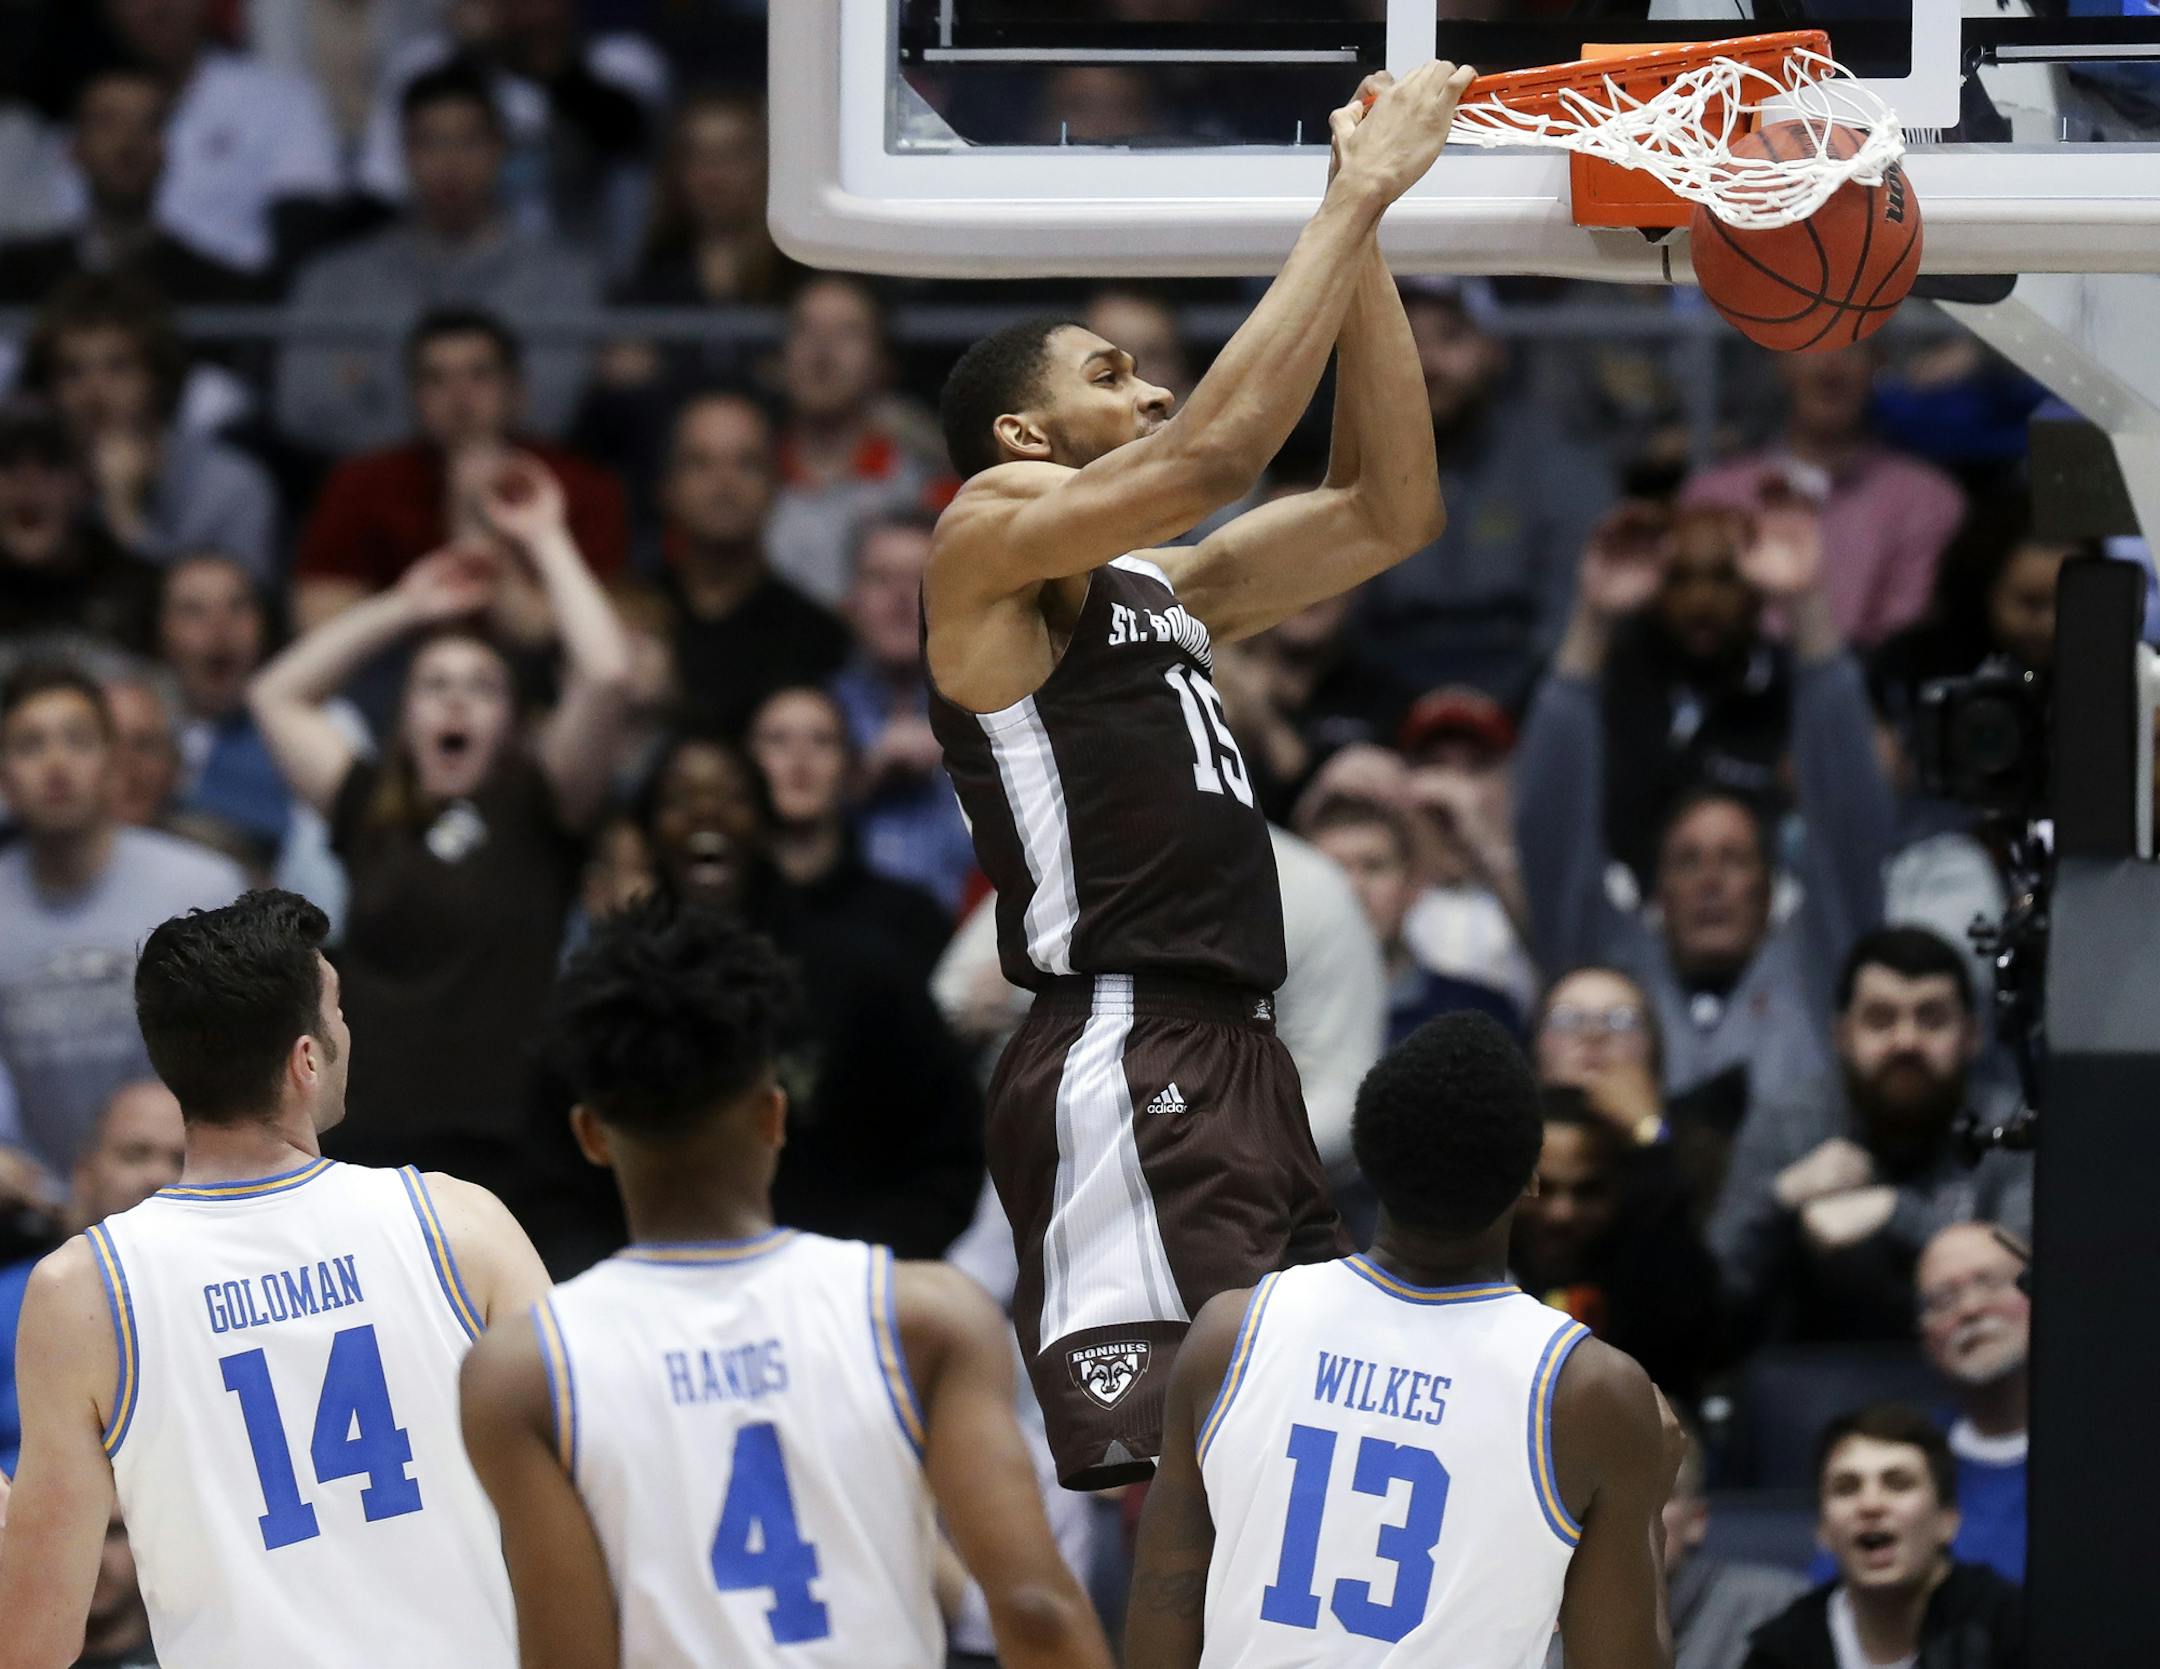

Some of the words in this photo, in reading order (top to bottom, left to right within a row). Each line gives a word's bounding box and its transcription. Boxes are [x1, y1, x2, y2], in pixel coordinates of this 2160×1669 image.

[1108, 602, 1147, 646] ST.
[1164, 662, 1254, 809] 15
[203, 1254, 364, 1334] GOLOMAN
[1072, 1343, 1147, 1363] BONNIES
[1313, 1350, 1452, 1426] WILKES
[218, 1323, 424, 1551] 14
[710, 1421, 832, 1645] 4
[1259, 1423, 1451, 1645] 13
